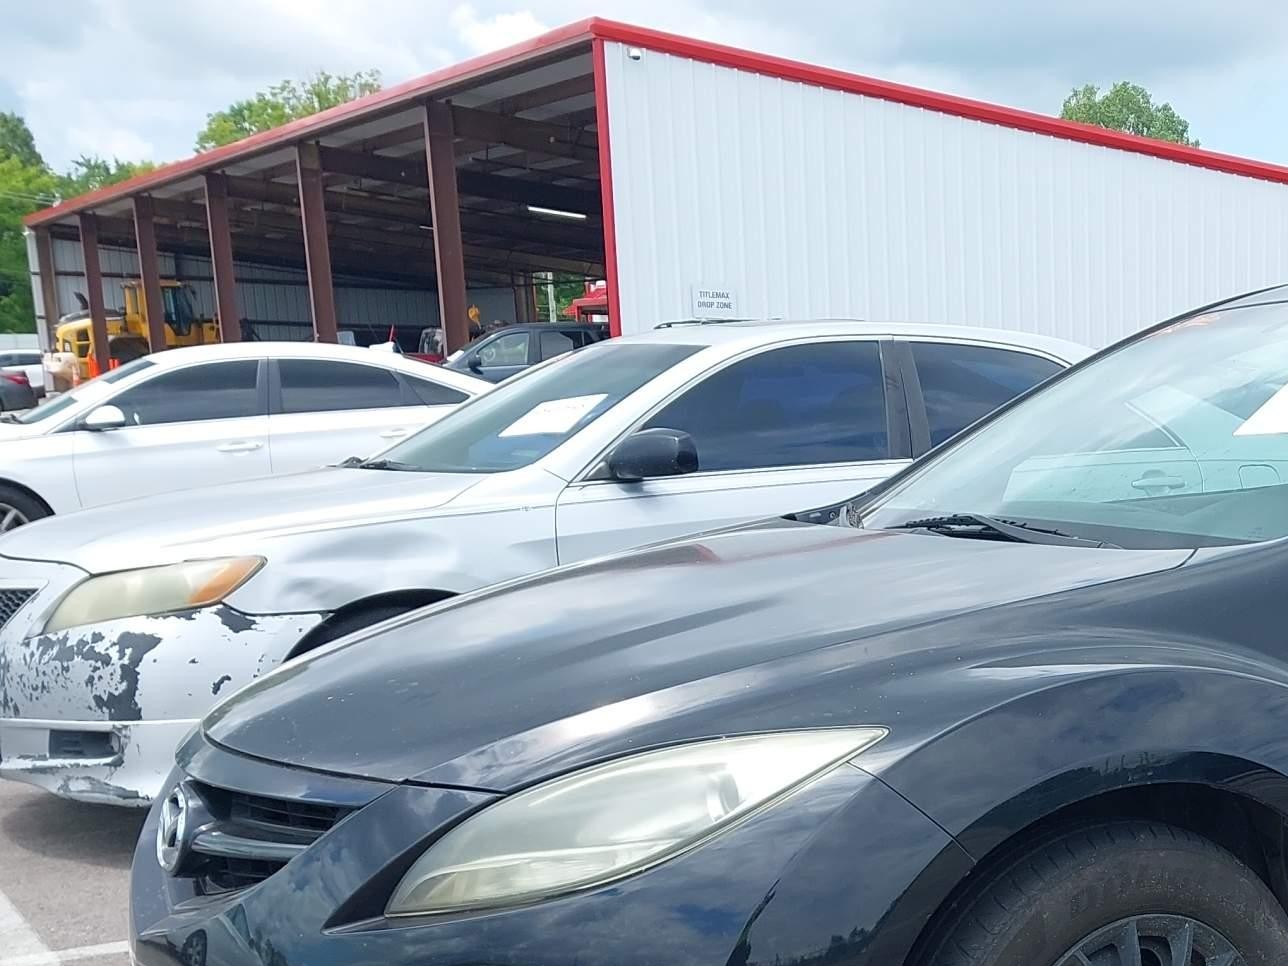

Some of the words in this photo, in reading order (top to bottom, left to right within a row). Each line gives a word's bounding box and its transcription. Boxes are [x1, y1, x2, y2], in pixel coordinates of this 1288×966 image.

[699, 290, 729, 299] TITLEMAX
[698, 300, 714, 309] DROP
[716, 301, 732, 310] ZONE
